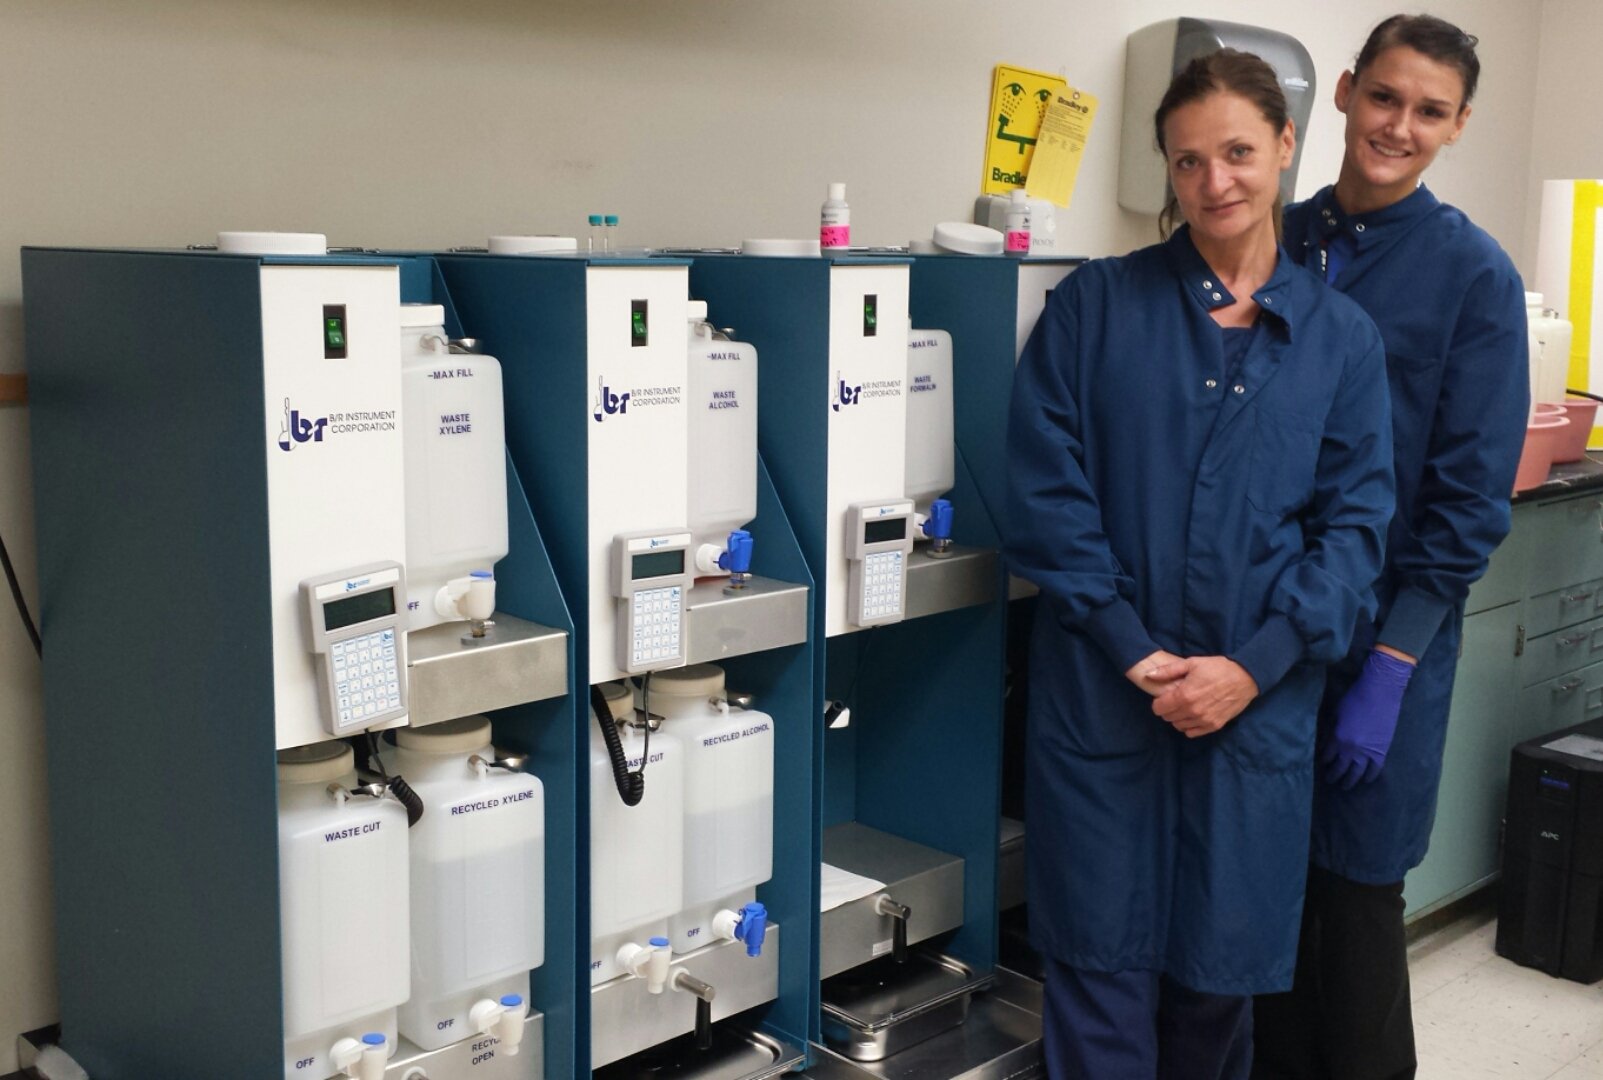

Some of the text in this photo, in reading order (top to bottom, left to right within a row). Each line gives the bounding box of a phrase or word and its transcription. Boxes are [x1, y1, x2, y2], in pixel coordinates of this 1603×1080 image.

[992, 167, 1027, 186] Bradle
[728, 352, 741, 360] FILL
[457, 368, 473, 377] FILL
[871, 380, 901, 389] INSTRUMENT
[914, 375, 931, 383] WASTE
[631, 386, 681, 397] B/R INSTRUMENT
[713, 390, 736, 399] WASTE
[863, 389, 901, 399] CORPORATION
[603, 386, 630, 415] br
[632, 396, 680, 407] CORPORATION
[708, 400, 739, 410] ALCOHOL
[329, 410, 396, 422] B/R INSTRUMENT
[440, 413, 470, 423] WASTE
[290, 410, 328, 442] br
[331, 422, 395, 434] CORPORATION
[439, 424, 472, 435] XYLENE
[703, 722, 770, 748] RECYCLED ALCOHOL
[650, 752, 664, 763] CUT
[450, 789, 534, 816] RECYCLED XYLENE
[324, 820, 382, 843] WASTE CUT
[1540, 830, 1560, 841] APC
[687, 927, 700, 938] OFF
[437, 1019, 455, 1031] OFF
[296, 1057, 315, 1070] OFF
[472, 1050, 495, 1066] OPEN
